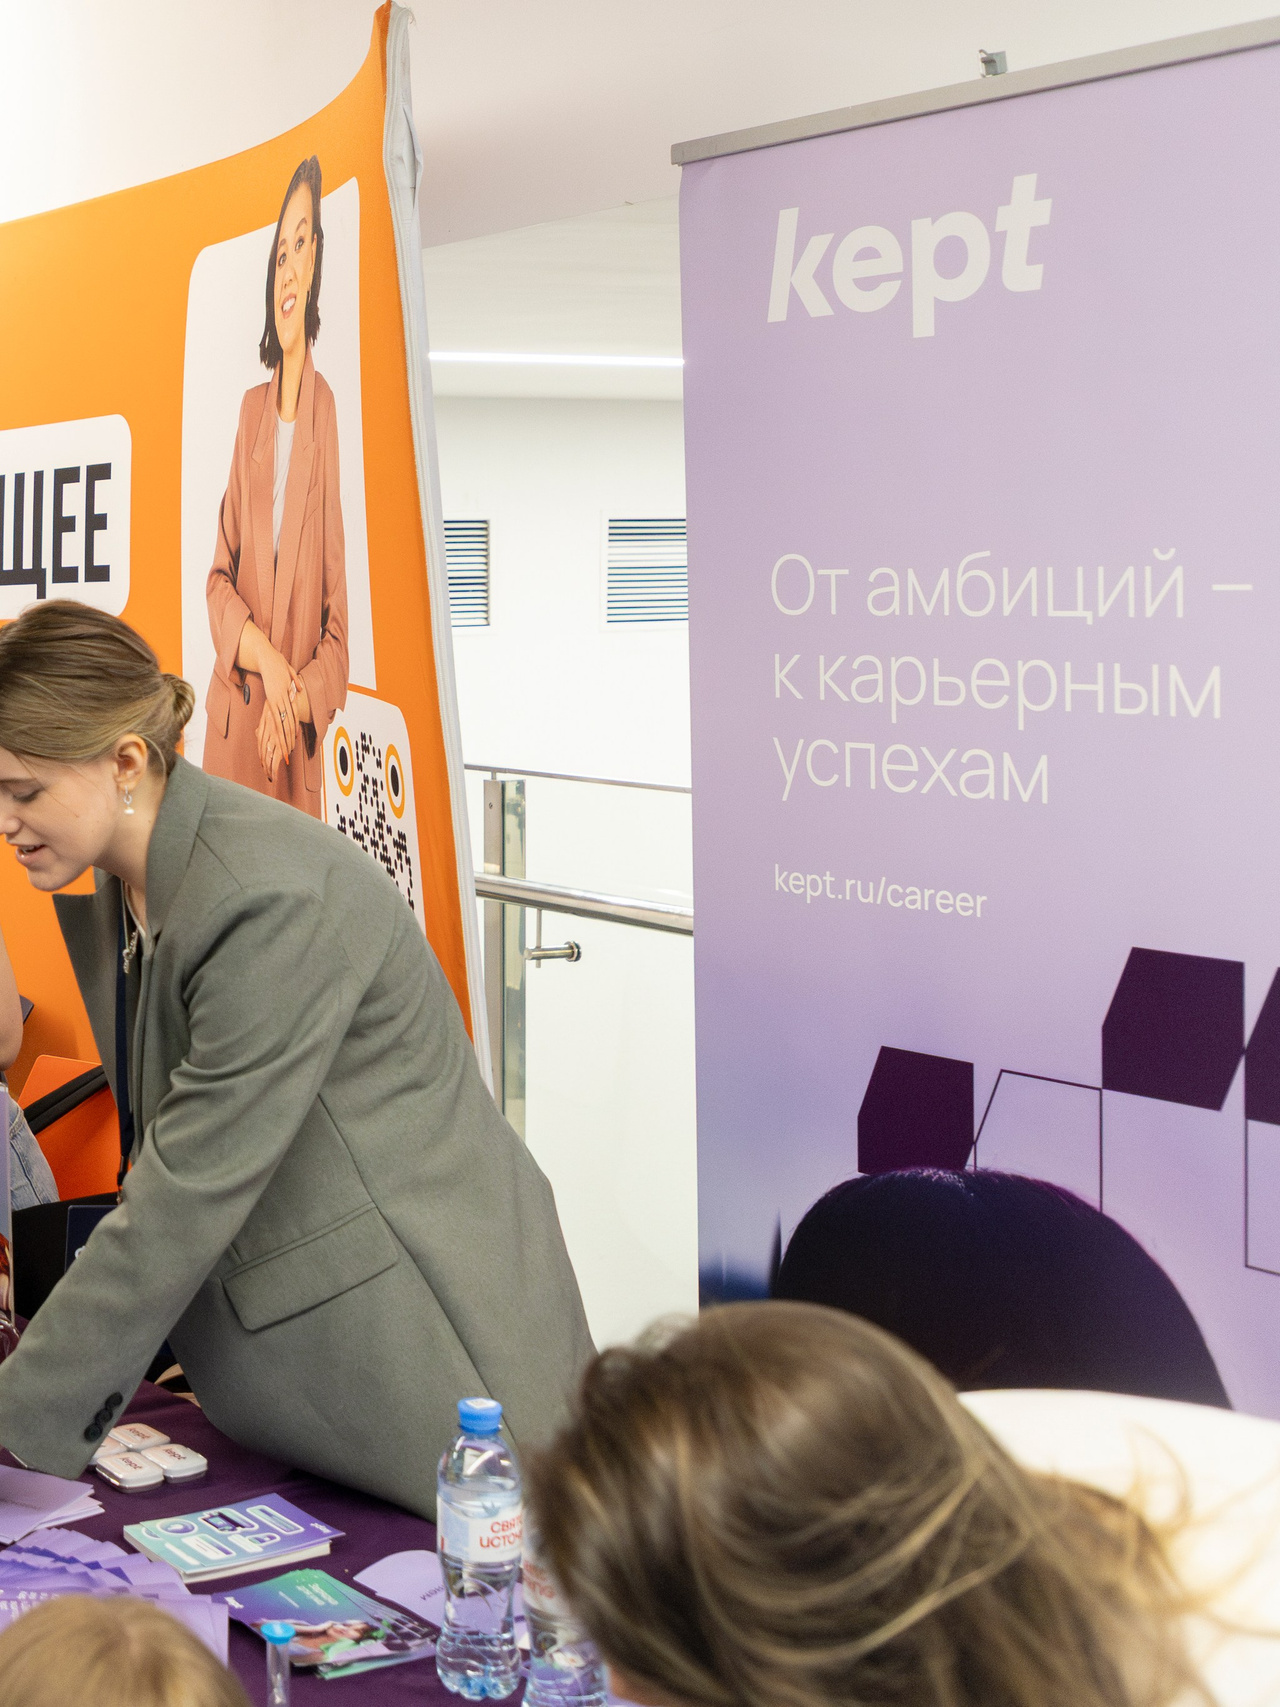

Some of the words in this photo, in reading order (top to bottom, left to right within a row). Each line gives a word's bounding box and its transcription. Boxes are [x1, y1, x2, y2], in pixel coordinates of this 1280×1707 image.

[767, 173, 1051, 338] kept
[771, 553, 849, 616] От
[866, 547, 1186, 625] амбиций
[774, 653, 804, 700] к
[819, 654, 1221, 731] карьерным
[773, 736, 1049, 804] успехам
[774, 863, 987, 917] kept.ru/career
